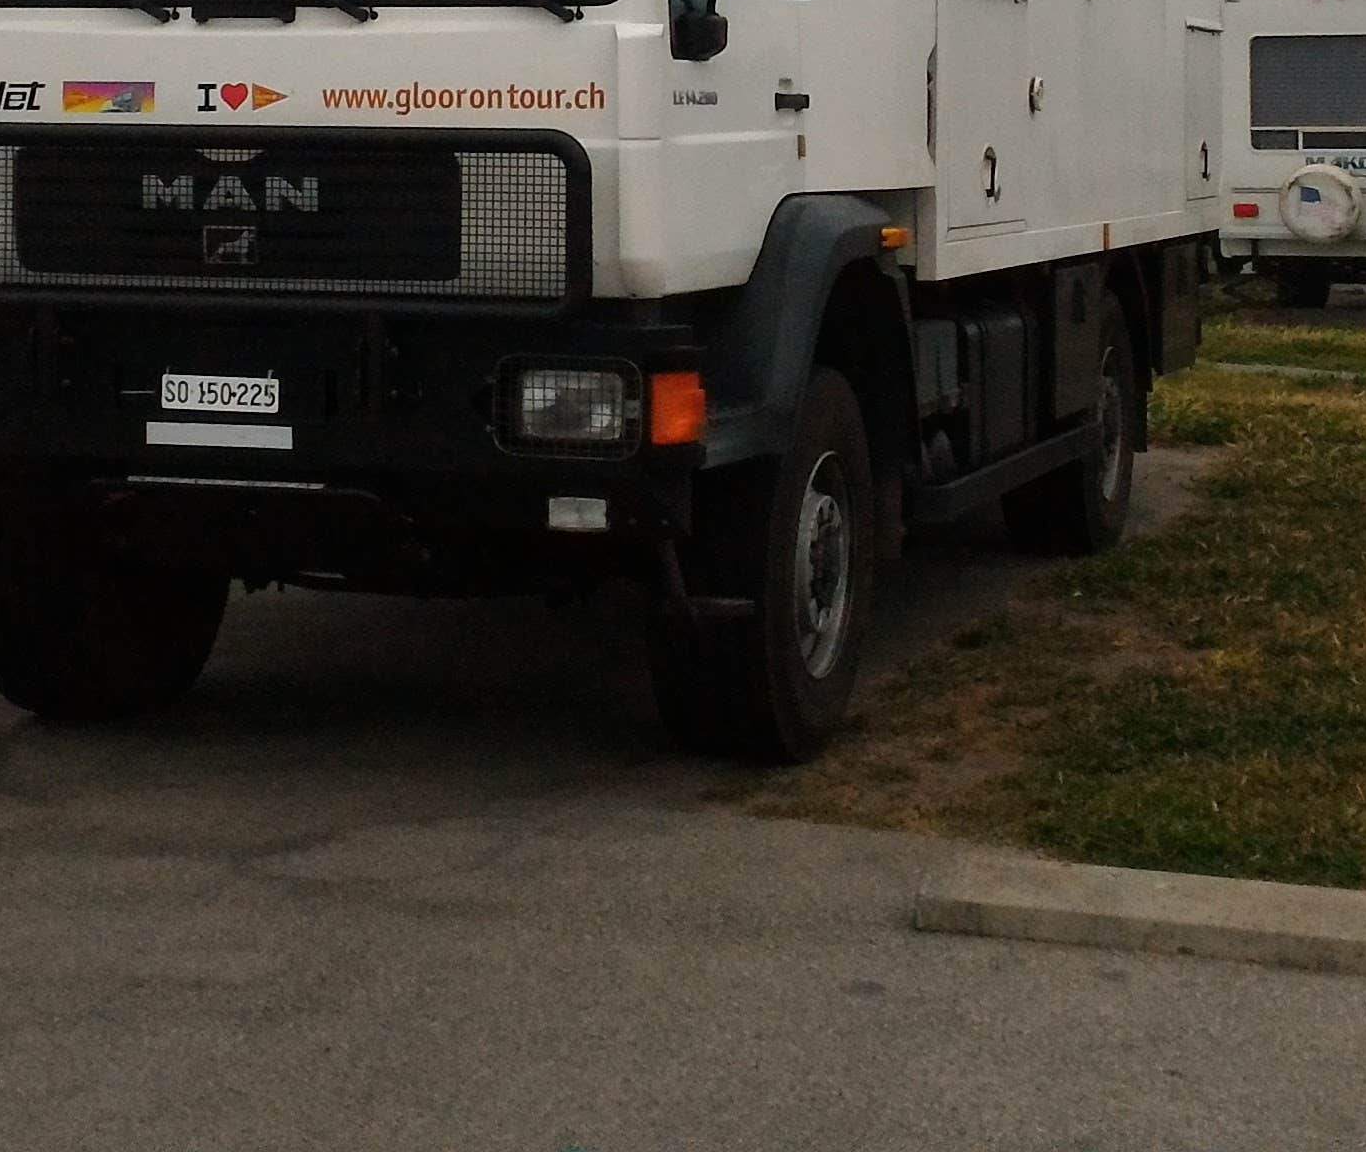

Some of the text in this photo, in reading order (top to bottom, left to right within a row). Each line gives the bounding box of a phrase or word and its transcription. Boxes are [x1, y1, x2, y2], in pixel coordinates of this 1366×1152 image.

[198, 83, 217, 111] I
[322, 81, 606, 116] www.gloorontour.ch
[141, 174, 320, 213] MAN
